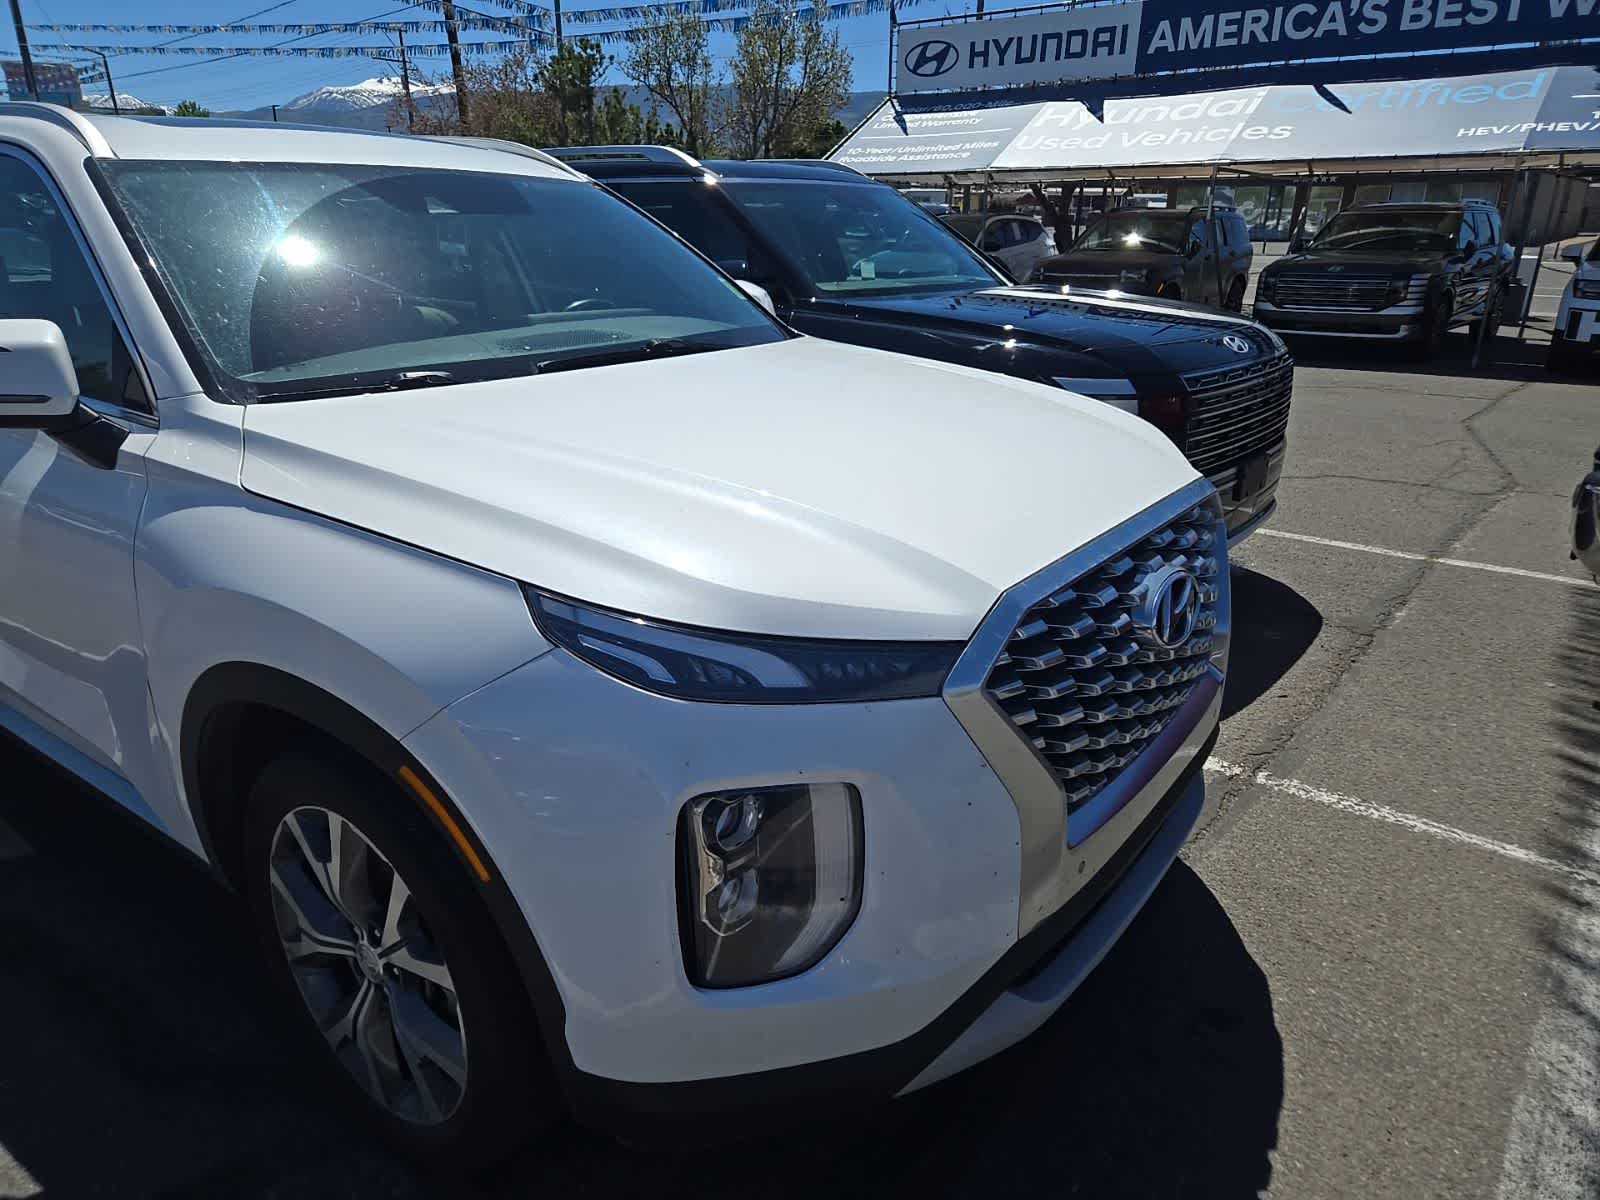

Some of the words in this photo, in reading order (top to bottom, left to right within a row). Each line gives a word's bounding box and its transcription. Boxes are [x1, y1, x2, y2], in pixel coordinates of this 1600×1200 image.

[1147, 0, 1392, 54] AMERICA'S
[968, 24, 1129, 69] HYUNDAI
[922, 117, 983, 128] Warranty
[1033, 91, 1266, 131] Hyundai
[847, 143, 962, 155] 10-Year/Unlimited
[961, 140, 1000, 150] Miles
[1016, 128, 1111, 150] Used
[1120, 121, 1294, 148] Vehicles
[838, 155, 896, 163] Roadside
[896, 151, 971, 161] Assistance
